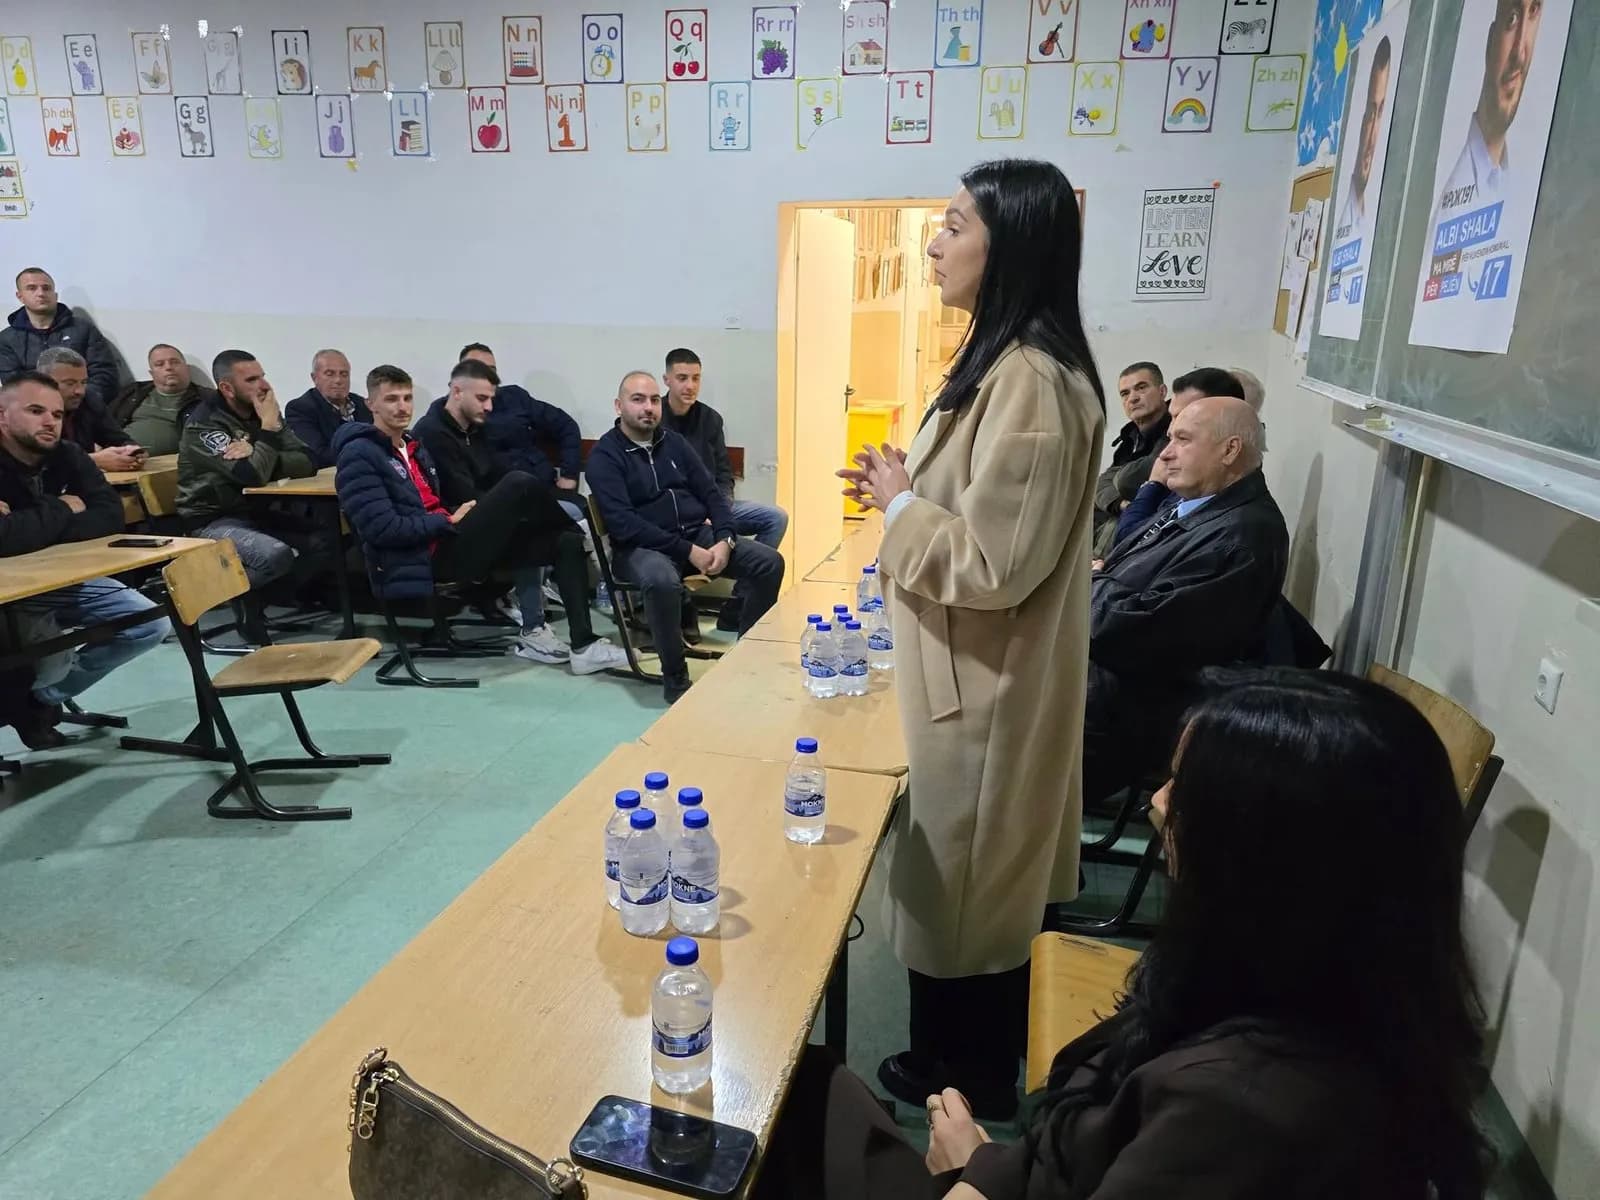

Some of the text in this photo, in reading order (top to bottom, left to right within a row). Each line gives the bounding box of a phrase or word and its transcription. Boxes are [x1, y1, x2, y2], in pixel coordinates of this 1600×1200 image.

[939, 6, 980, 23] Th th
[1037, 0, 1073, 16] V v
[669, 18, 703, 42] Q q
[755, 16, 793, 33] Rr rr
[868, 14, 886, 28] sh
[507, 24, 539, 43] N n
[586, 22, 619, 41] O o
[70, 42, 93, 58] E e
[140, 38, 162, 56] F f
[293, 37, 299, 56] i
[353, 34, 379, 53] K k
[986, 75, 1021, 94] U u
[1080, 70, 1113, 90] X x
[1175, 65, 1212, 92] Y y
[1256, 67, 1298, 83] Zh zh
[717, 89, 744, 108] R r
[804, 87, 833, 105] S s
[896, 80, 925, 99] T t
[399, 98, 409, 116] L
[471, 95, 504, 112] M m
[548, 92, 583, 114] Nj nj
[631, 91, 661, 113] P p
[43, 106, 73, 119] Dh dh
[179, 103, 207, 124] G g
[324, 101, 344, 123] J j
[557, 113, 576, 147] 1
[1145, 207, 1210, 231] LISTEN
[1435, 225, 1459, 251] ALBI
[1460, 209, 1498, 243] SHALA
[1144, 231, 1207, 249] LEARN
[1481, 260, 1505, 297] 17
